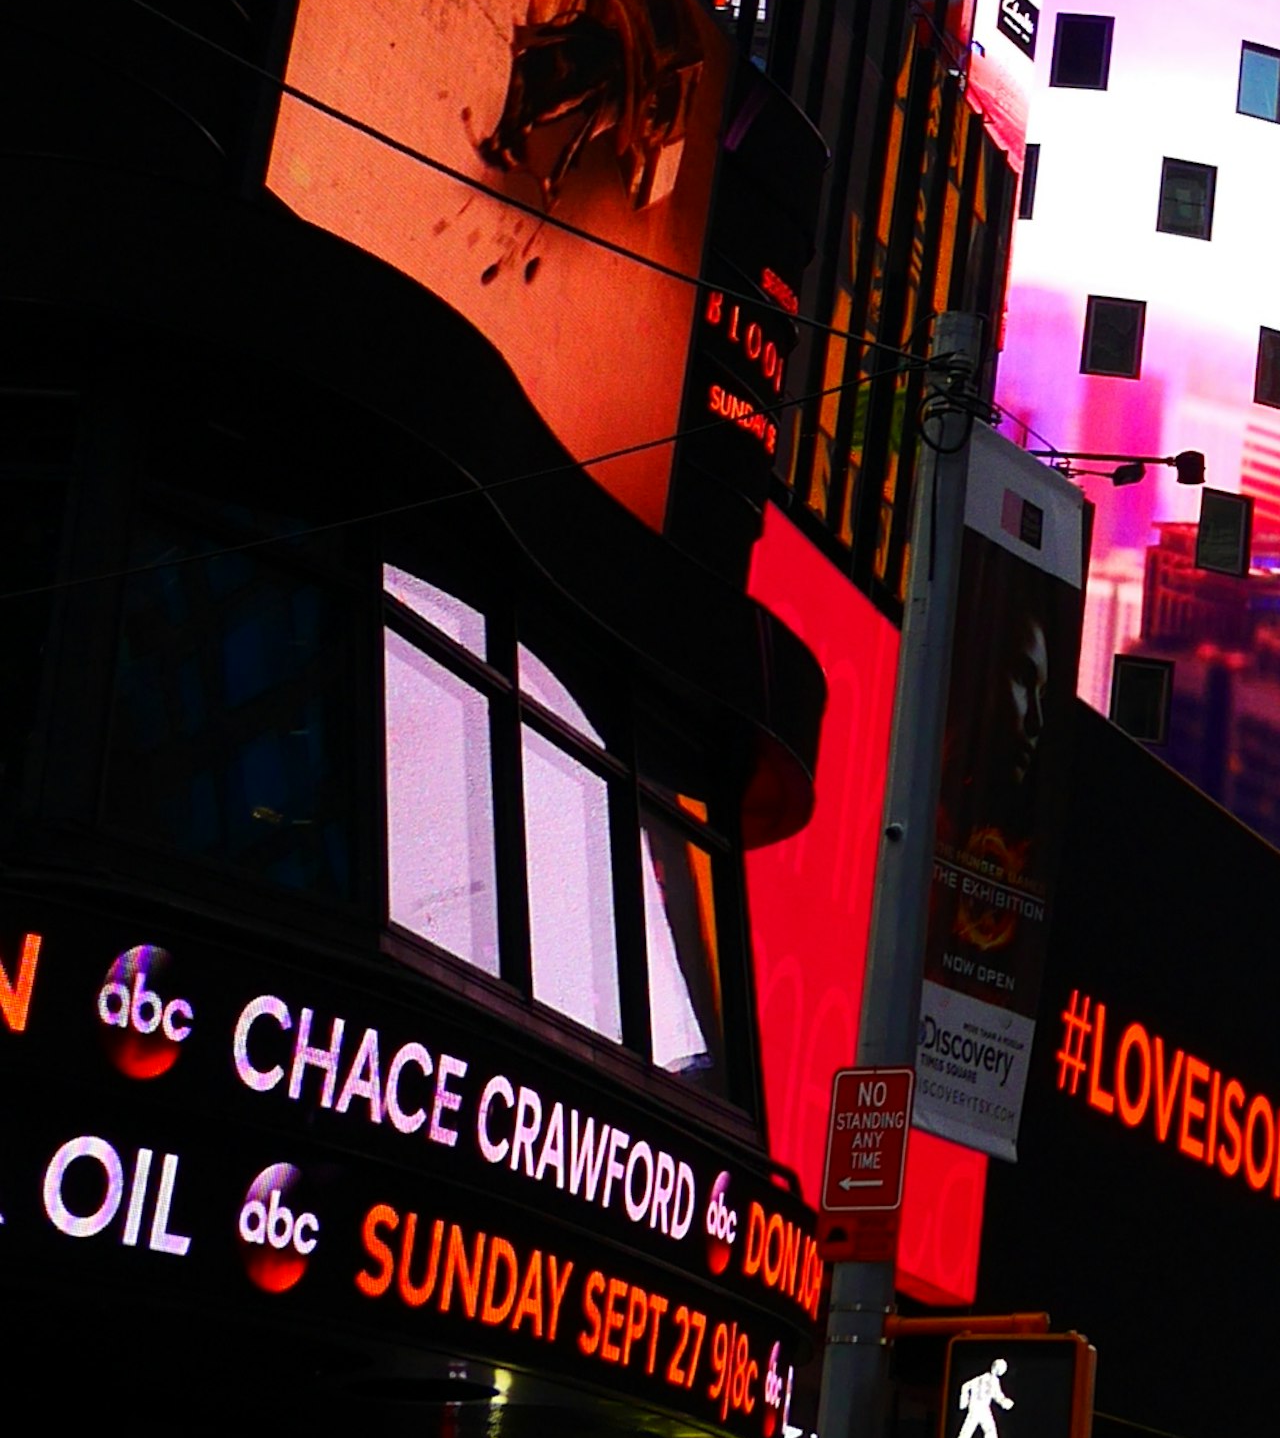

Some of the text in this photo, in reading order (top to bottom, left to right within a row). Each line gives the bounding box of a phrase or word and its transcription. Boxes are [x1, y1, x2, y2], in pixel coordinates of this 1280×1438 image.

[962, 874, 1044, 922] EXHIBITION
[943, 953, 1015, 991] NOW OPEN
[858, 1082, 887, 1107] NO
[98, 972, 194, 1042] abc
[233, 995, 468, 1146] CHACE
[477, 1075, 696, 1240] CRAWFORD
[707, 1193, 737, 1243] abc
[744, 1202, 801, 1294] DON
[837, 1112, 904, 1130] STANDING
[852, 1132, 883, 1149] ANY
[851, 1151, 882, 1169] TIME
[44, 1136, 191, 1256] OIL
[239, 1190, 320, 1254] abc
[354, 1204, 573, 1341] SUNDAY
[579, 1271, 668, 1374] SEPT
[667, 1306, 706, 1388] 27
